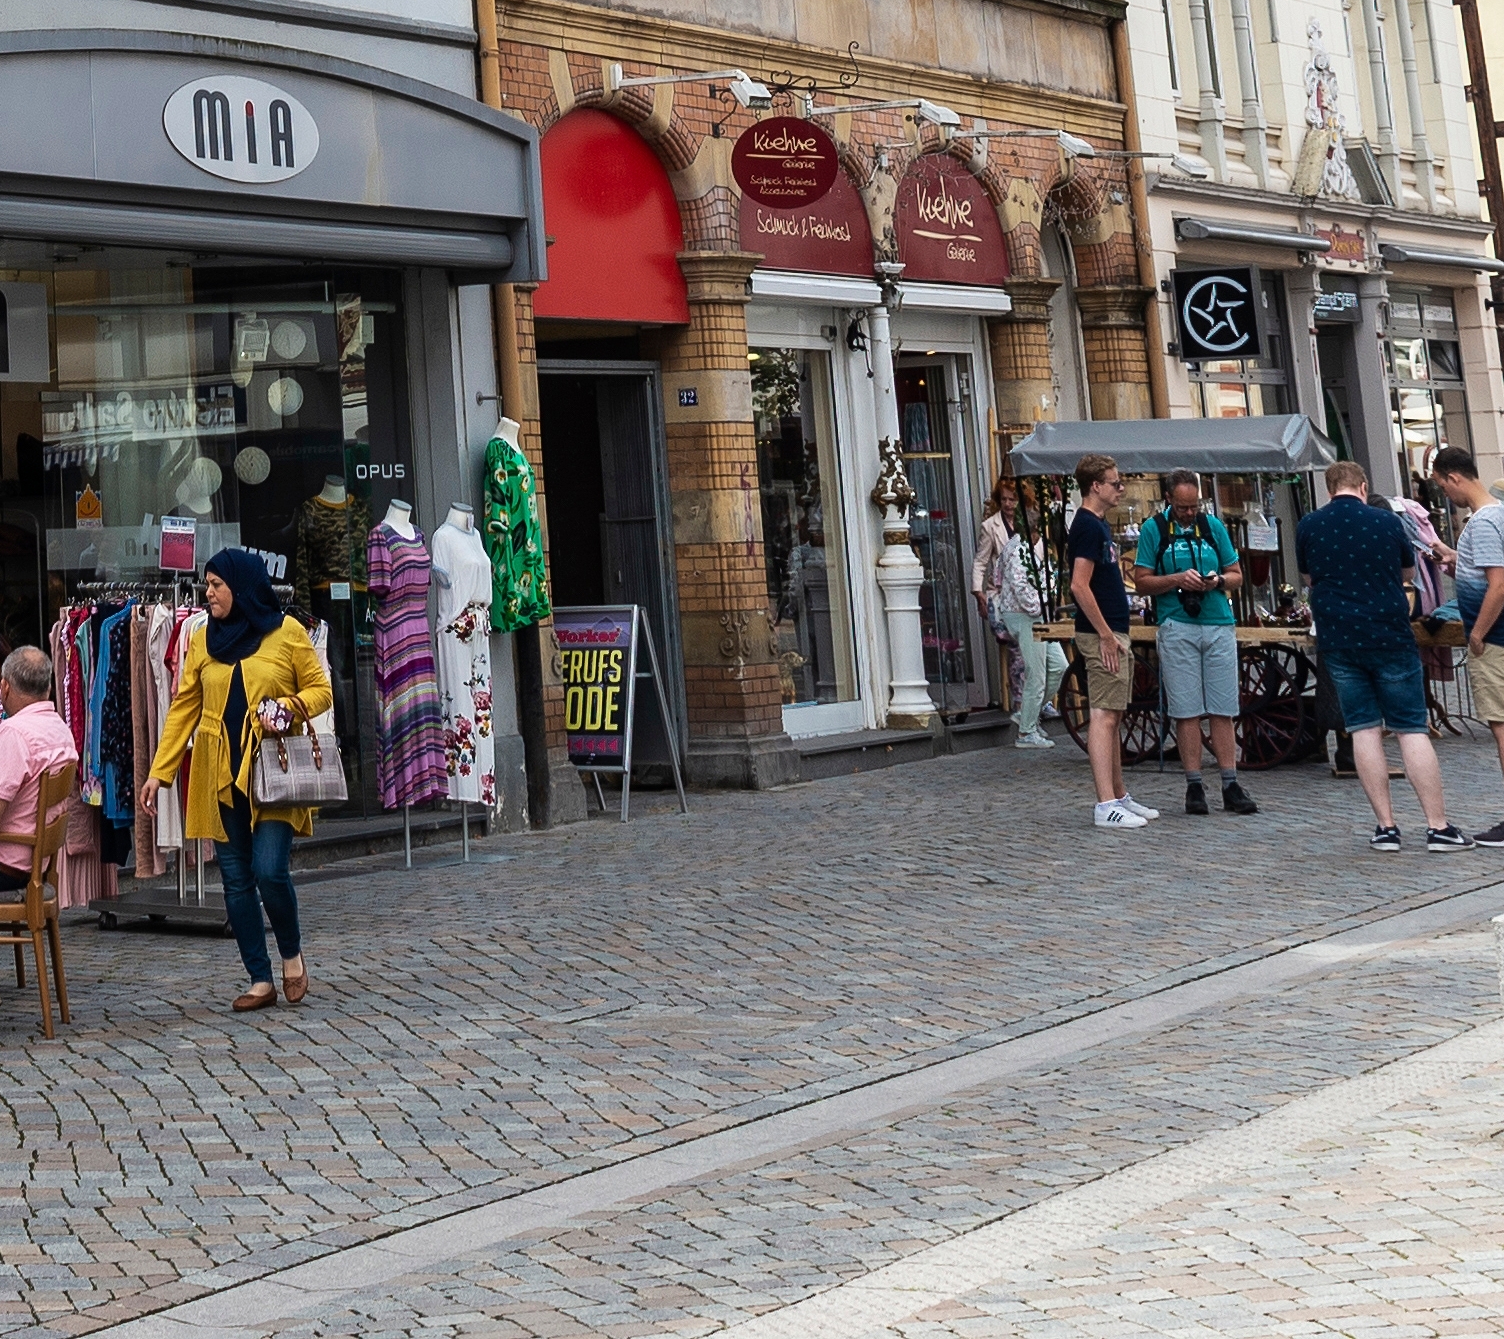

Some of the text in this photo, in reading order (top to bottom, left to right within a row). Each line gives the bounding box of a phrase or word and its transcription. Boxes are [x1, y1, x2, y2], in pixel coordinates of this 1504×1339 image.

[193, 89, 295, 168] MIA
[754, 127, 817, 153] Kiehne
[756, 208, 852, 242] Schmuck & Feinkost
[946, 242, 977, 263] Galerie
[680, 390, 695, 404] 32
[356, 464, 405, 479] OPUS
[561, 649, 623, 683] ERUFS
[565, 686, 621, 731] ODE
